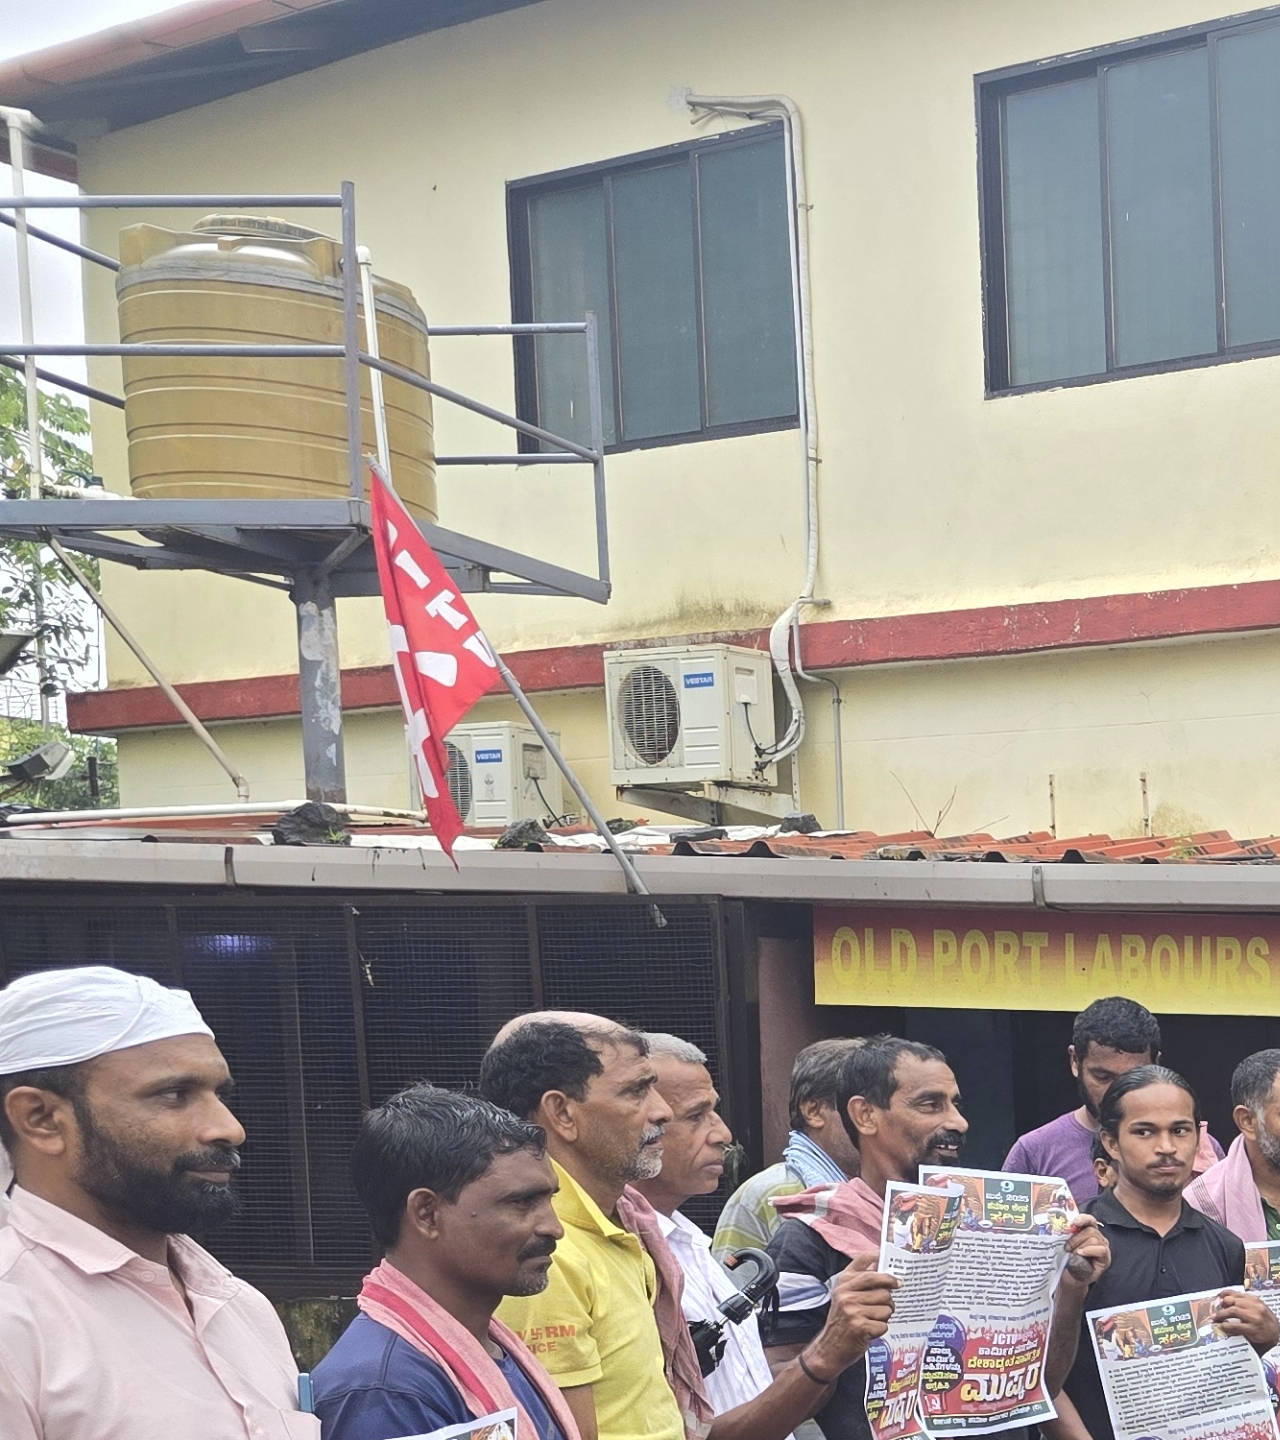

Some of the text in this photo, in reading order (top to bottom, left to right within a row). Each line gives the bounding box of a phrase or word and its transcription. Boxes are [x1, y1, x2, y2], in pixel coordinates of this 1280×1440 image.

[476, 752, 501, 760] VESTAR
[831, 926, 918, 985] OLD
[933, 929, 1048, 986] PORT
[1065, 931, 1271, 994] LABOURS
